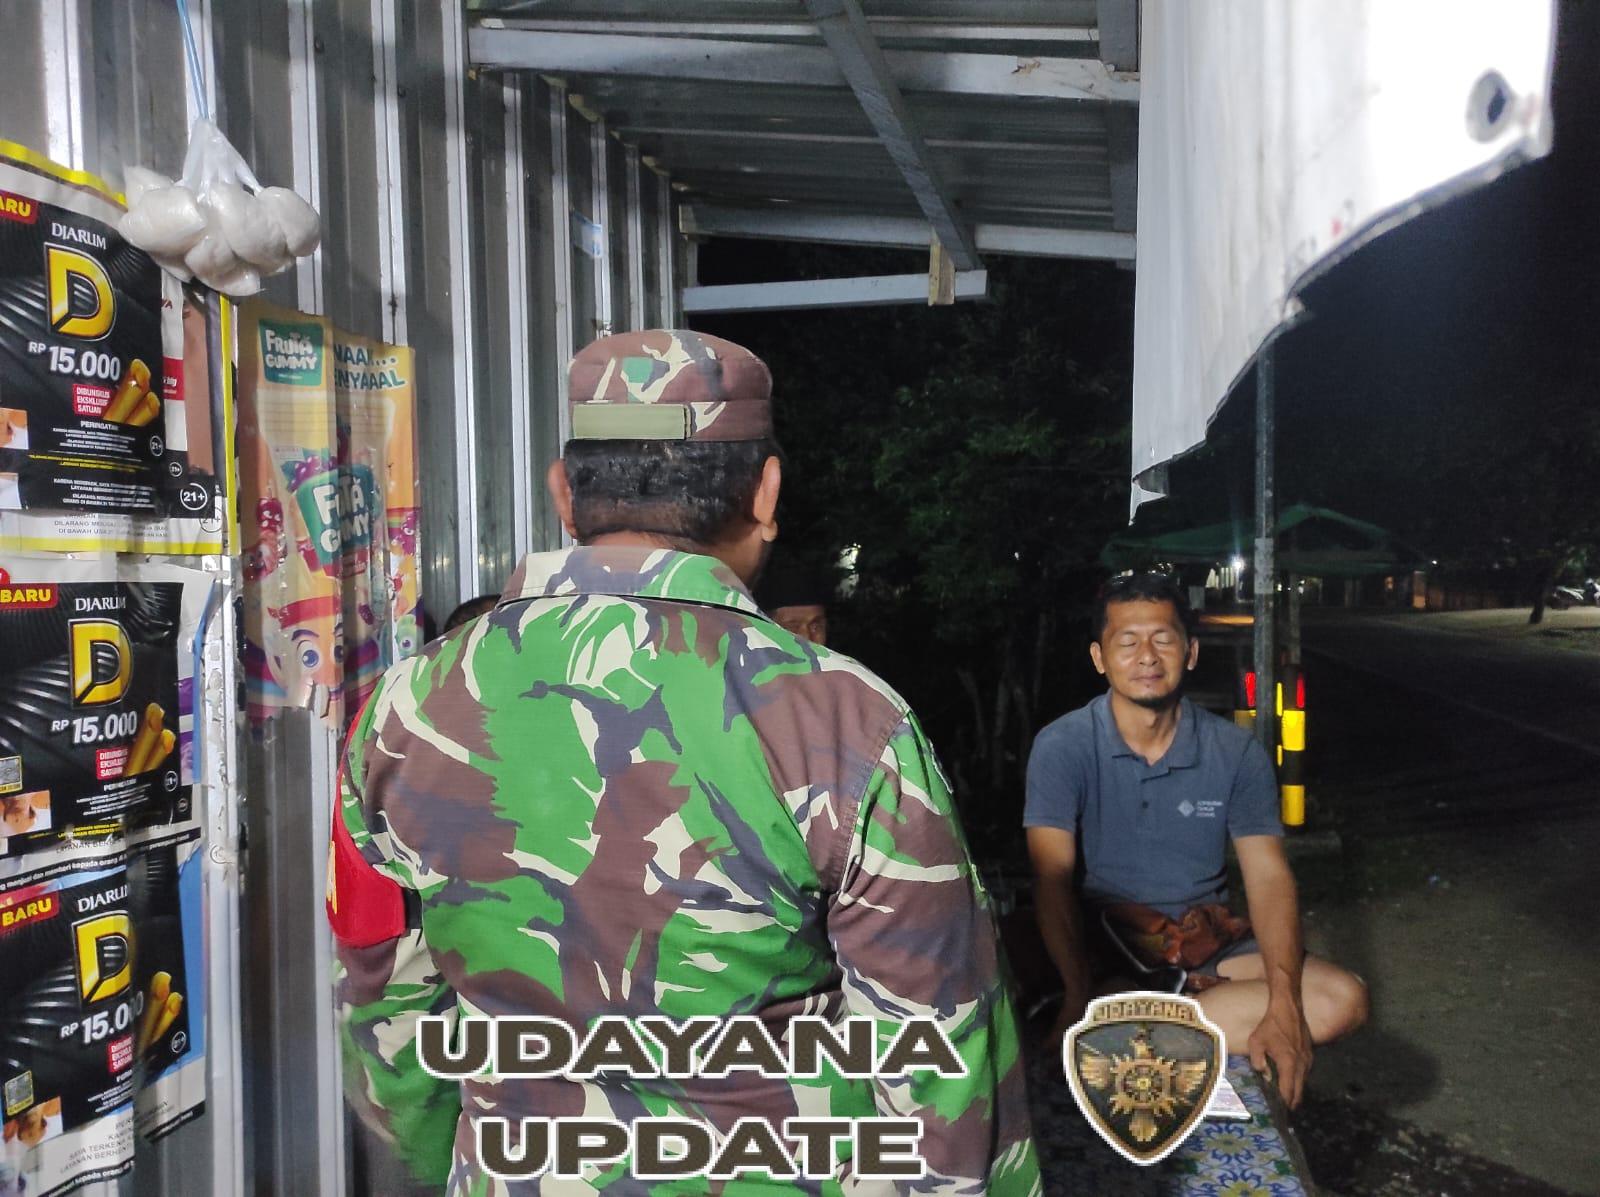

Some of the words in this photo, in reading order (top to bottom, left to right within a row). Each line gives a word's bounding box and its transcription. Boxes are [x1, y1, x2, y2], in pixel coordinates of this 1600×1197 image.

[52, 222, 107, 250] DJARUM
[28, 342, 46, 354] RP
[49, 346, 121, 382] 15.000
[265, 354, 318, 371] GUMMY
[183, 491, 206, 503] 21+
[0, 588, 51, 604] BARU
[75, 597, 126, 612] DJARUM
[52, 720, 70, 732] RP
[73, 711, 138, 744] 15.000
[2, 897, 52, 927] BARU
[60, 1022, 79, 1039] RP
